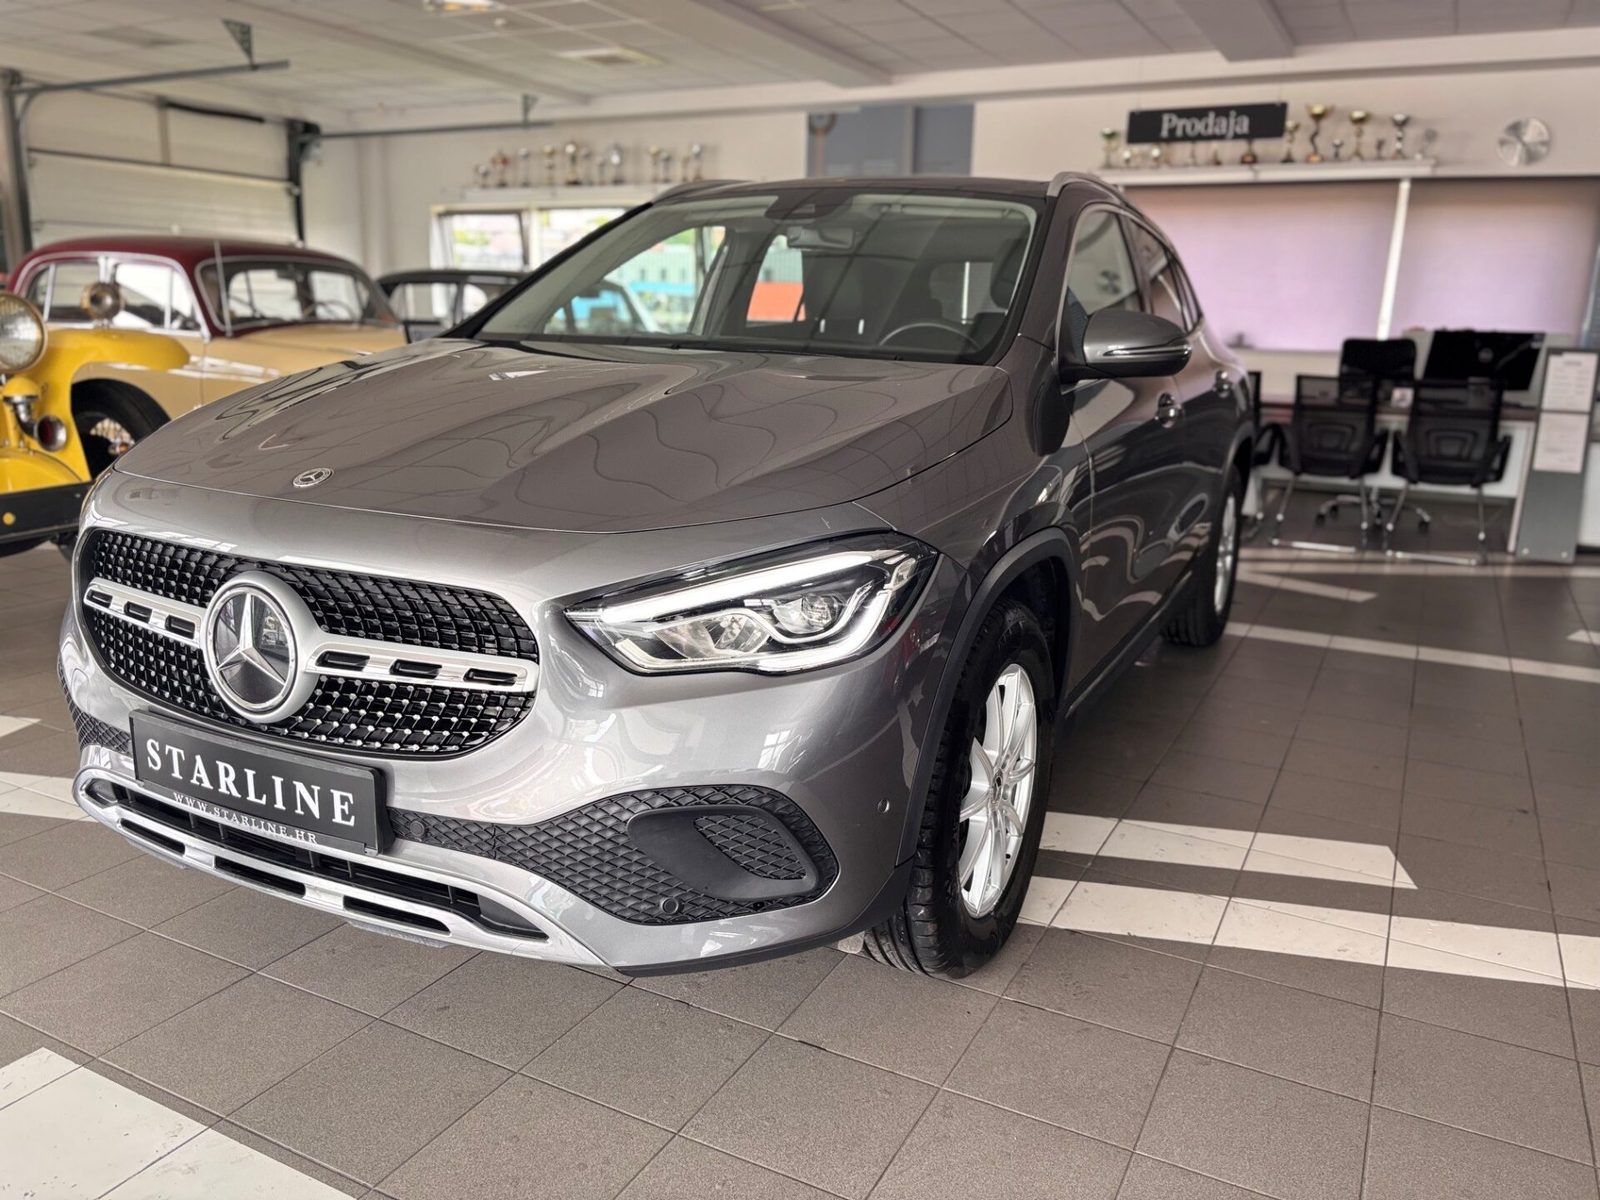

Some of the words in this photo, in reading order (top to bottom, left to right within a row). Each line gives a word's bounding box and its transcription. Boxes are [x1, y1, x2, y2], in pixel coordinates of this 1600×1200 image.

[1161, 110, 1250, 139] Prodaja
[146, 738, 355, 827] STARLINE
[173, 792, 318, 844] WWW.STARLINE.HR
